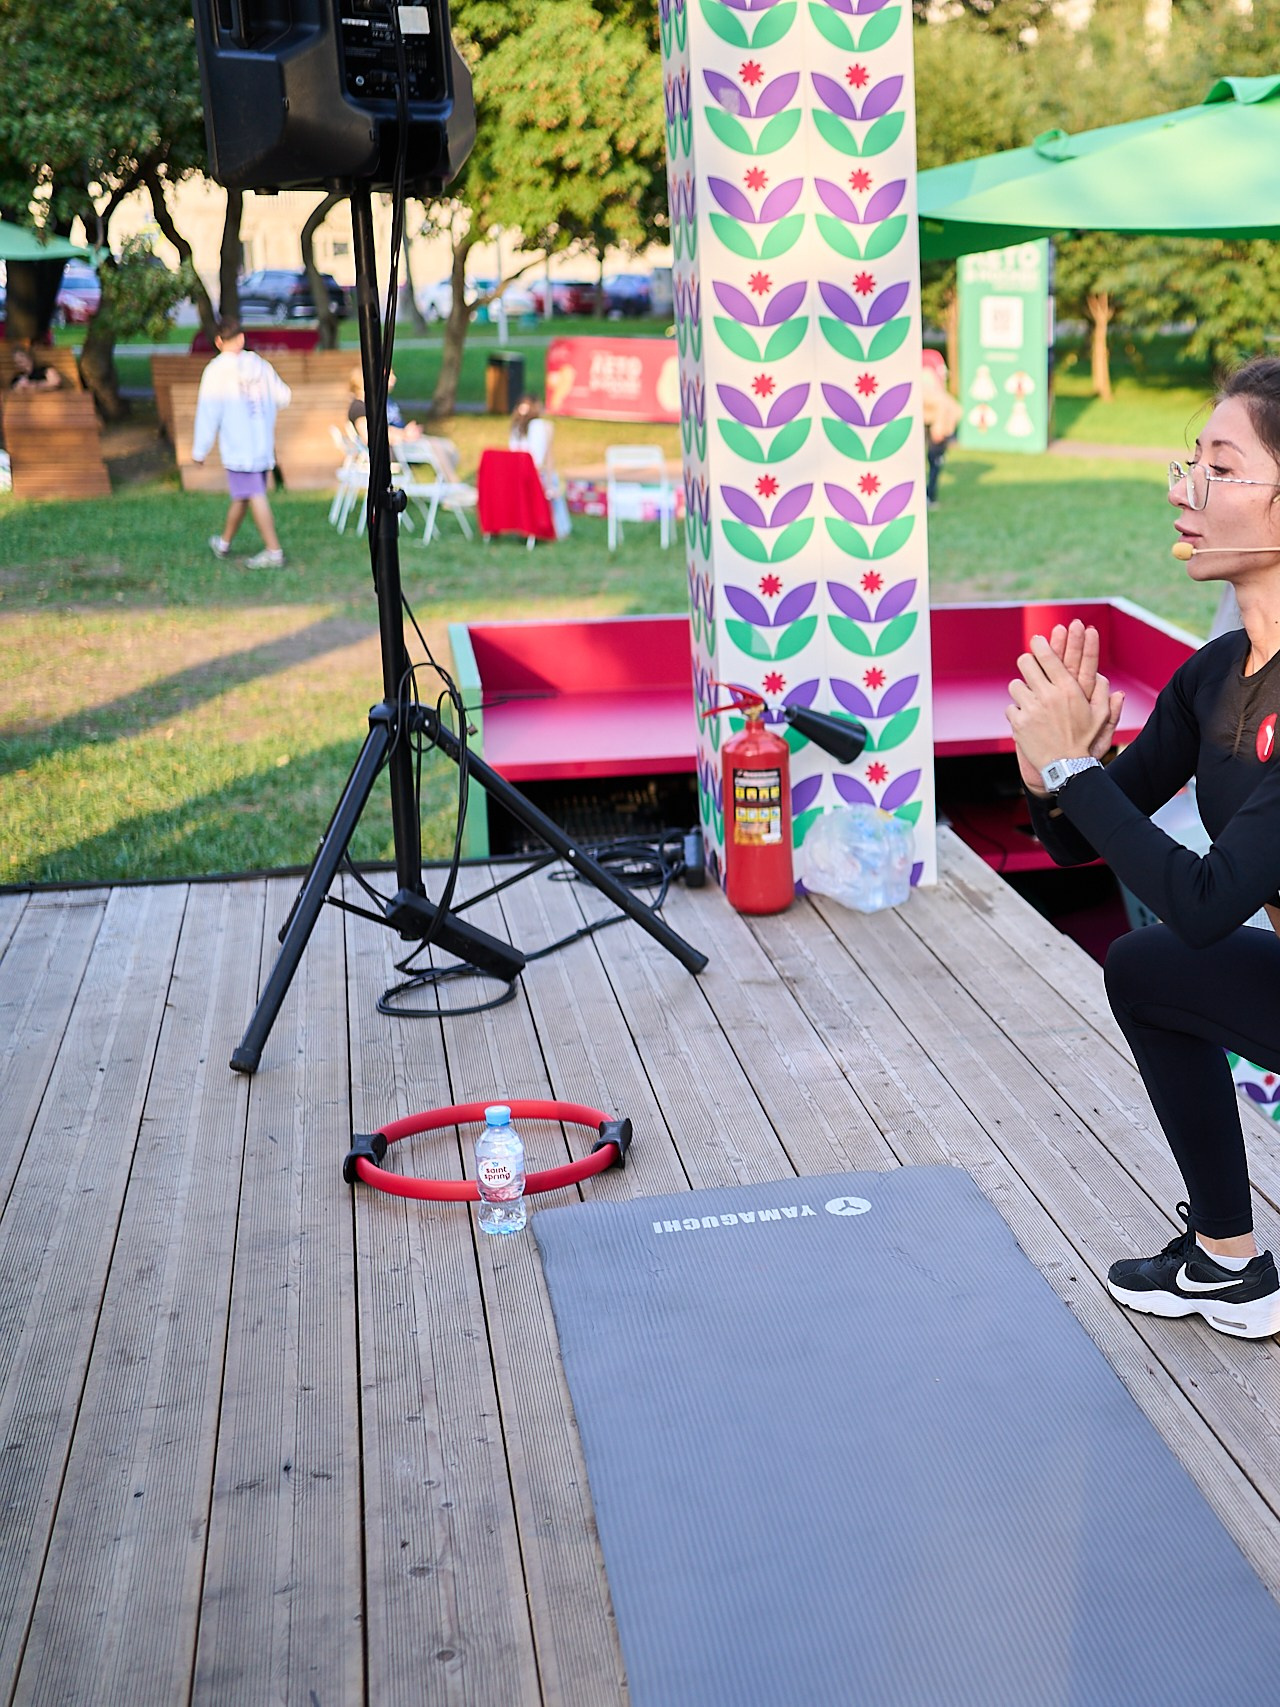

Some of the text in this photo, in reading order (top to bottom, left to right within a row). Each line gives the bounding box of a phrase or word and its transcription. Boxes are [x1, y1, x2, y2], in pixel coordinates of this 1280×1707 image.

[486, 1166, 508, 1174] saint
[484, 1172, 511, 1182] spring
[652, 1204, 817, 1234] YAMAGUCHI
